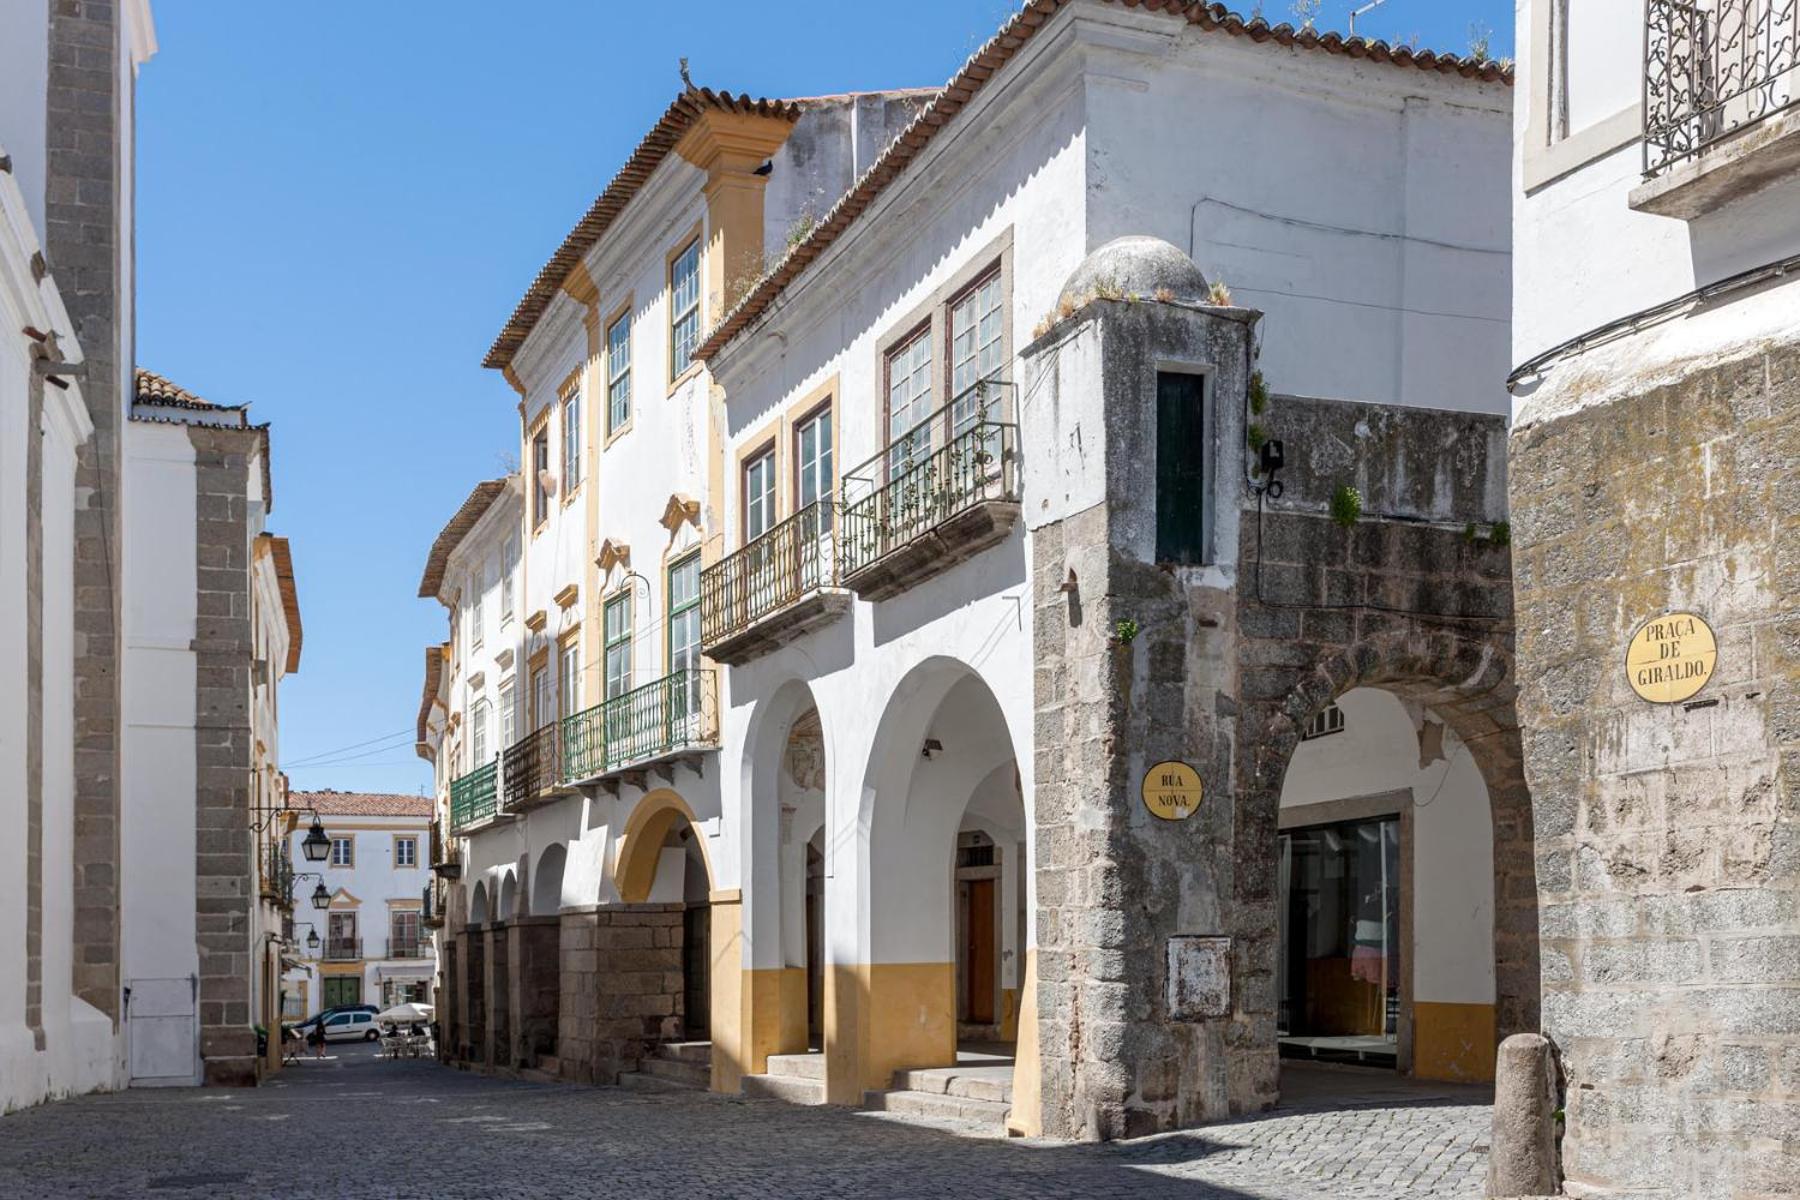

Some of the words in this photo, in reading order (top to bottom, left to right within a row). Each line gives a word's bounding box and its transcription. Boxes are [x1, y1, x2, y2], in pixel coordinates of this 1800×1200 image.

[1646, 618, 1695, 642] PRAÇA
[1660, 640, 1681, 660] DE
[1638, 660, 1707, 686] GIRALDO.
[1161, 774, 1183, 787] RUA
